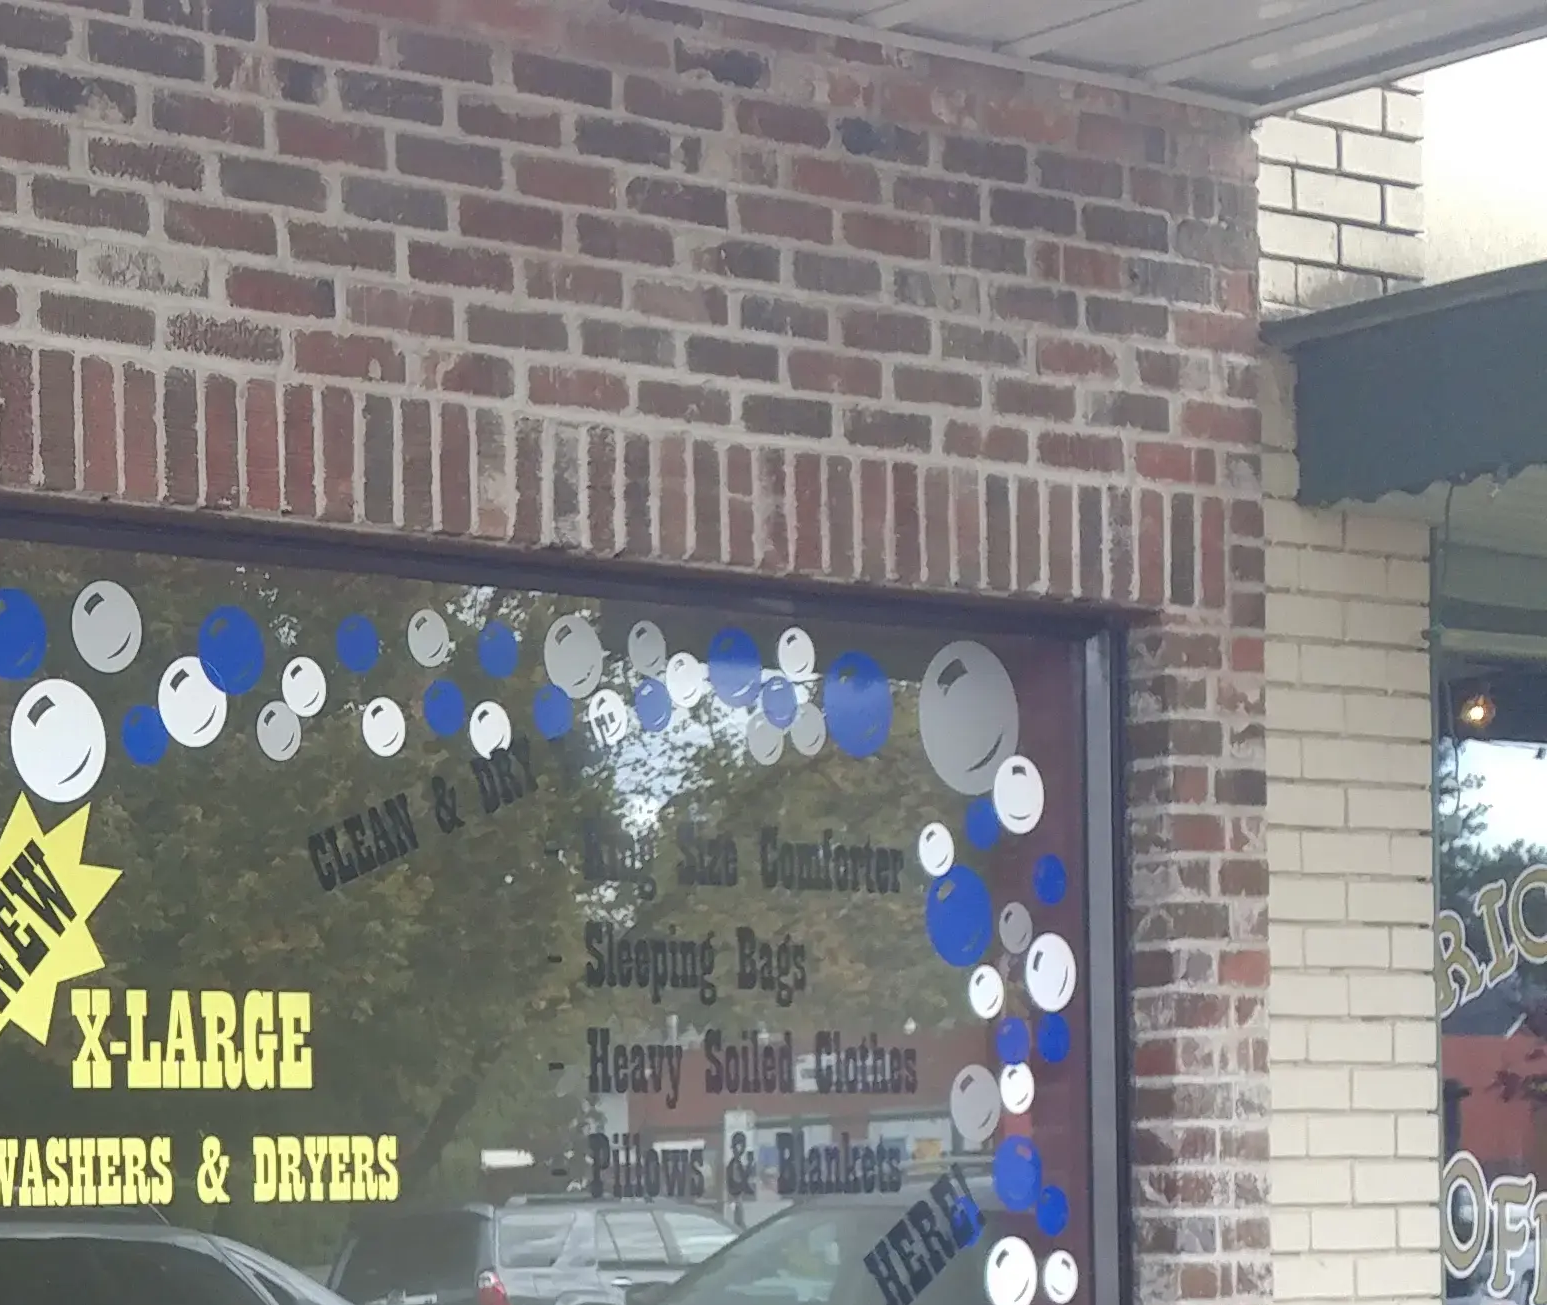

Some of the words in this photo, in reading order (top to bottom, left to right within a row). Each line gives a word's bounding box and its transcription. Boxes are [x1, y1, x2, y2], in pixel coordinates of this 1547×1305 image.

[309, 793, 419, 891] CLEAN
[432, 776, 465, 834] &
[471, 732, 538, 814] DRY
[676, 823, 739, 887] Size
[760, 826, 905, 894] Comforter
[585, 921, 717, 1005] Sleeping
[736, 926, 806, 1007] Bags
[71, 988, 313, 1090] X-LARGE
[587, 1027, 683, 1109] Heavy
[704, 1028, 795, 1094] Soiled
[814, 1030, 918, 1094] Clothes
[196, 1135, 231, 1204] &
[252, 1135, 400, 1202] DRYERS
[588, 1132, 705, 1198] Pillows
[726, 1131, 755, 1195] &
[775, 1131, 903, 1194] Blankets
